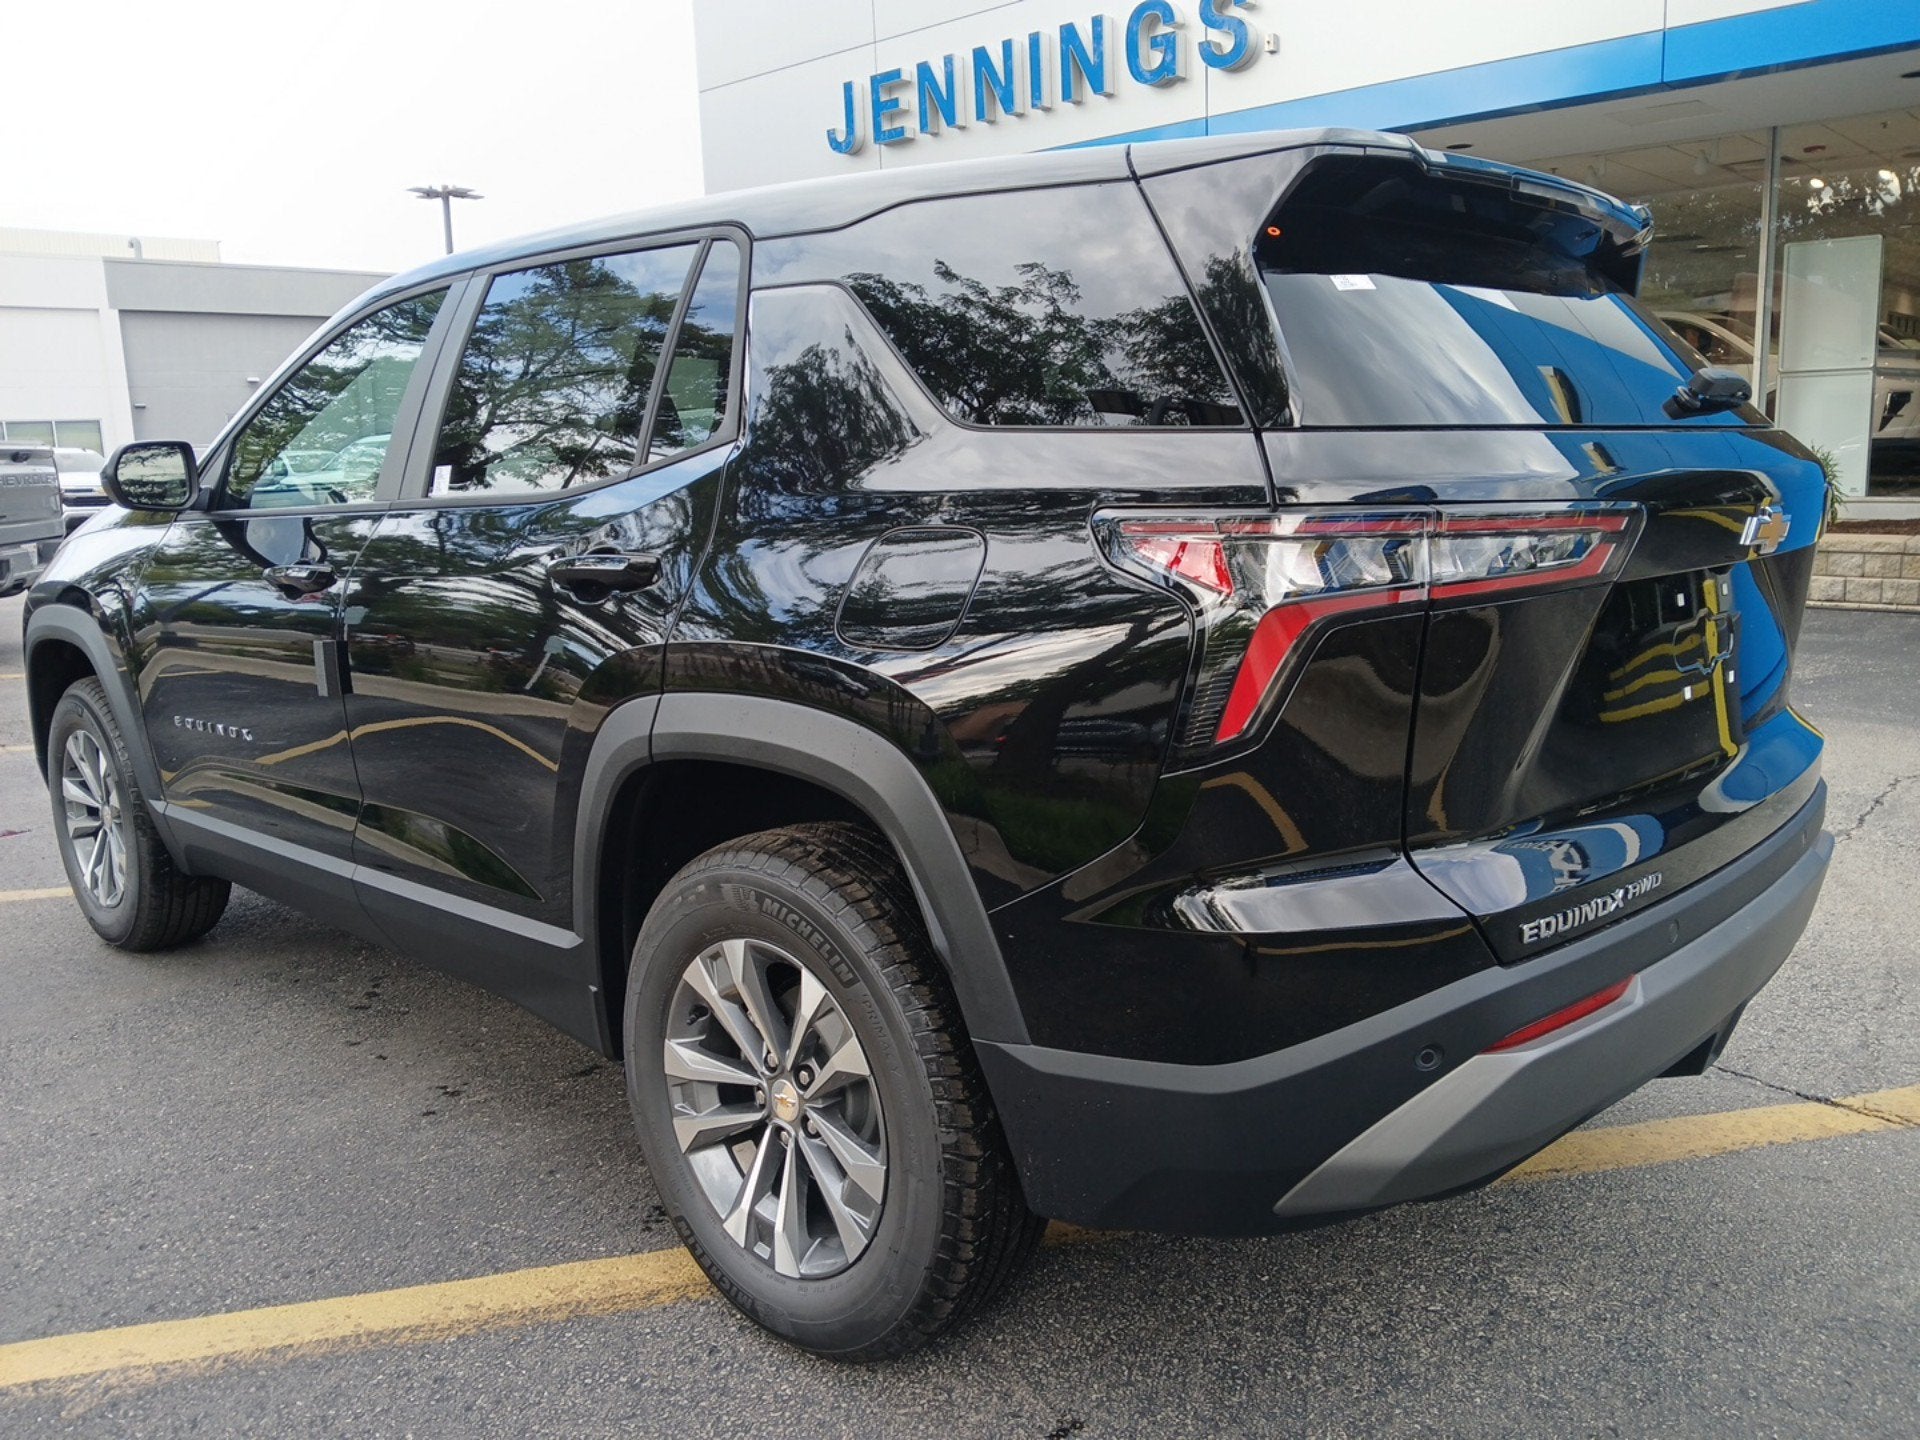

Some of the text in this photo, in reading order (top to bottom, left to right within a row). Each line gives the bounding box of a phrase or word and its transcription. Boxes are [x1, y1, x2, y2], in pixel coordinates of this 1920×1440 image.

[826, 0, 1259, 155] JENNINGS
[174, 715, 254, 741] EQUINOX
[762, 897, 854, 983] MICHELIN
[1520, 871, 1663, 944] EQUINOX AWD
